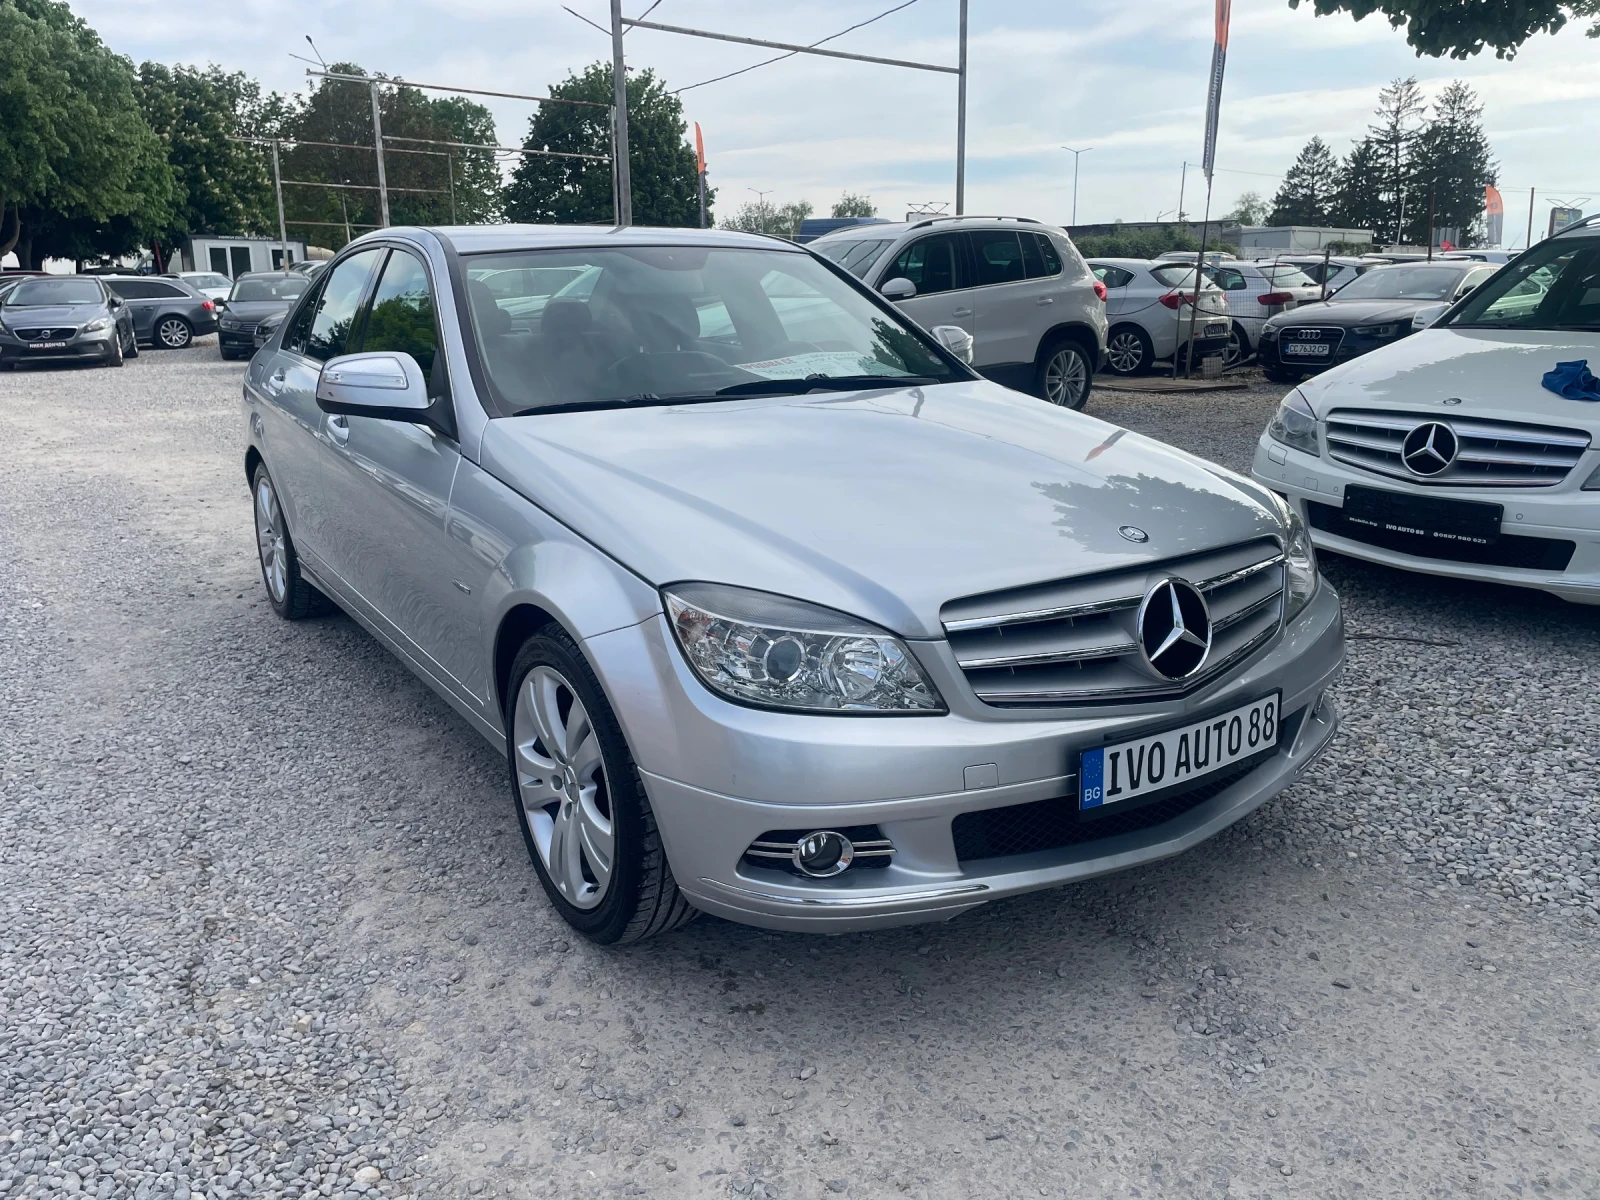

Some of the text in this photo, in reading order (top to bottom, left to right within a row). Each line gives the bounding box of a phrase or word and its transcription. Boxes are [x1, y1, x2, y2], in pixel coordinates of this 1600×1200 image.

[1289, 344, 1328, 353] CC 7632 CP
[1397, 526, 1415, 534] AUTO
[1106, 701, 1275, 797] IVO AUTO 88
[1084, 786, 1101, 802] BG
